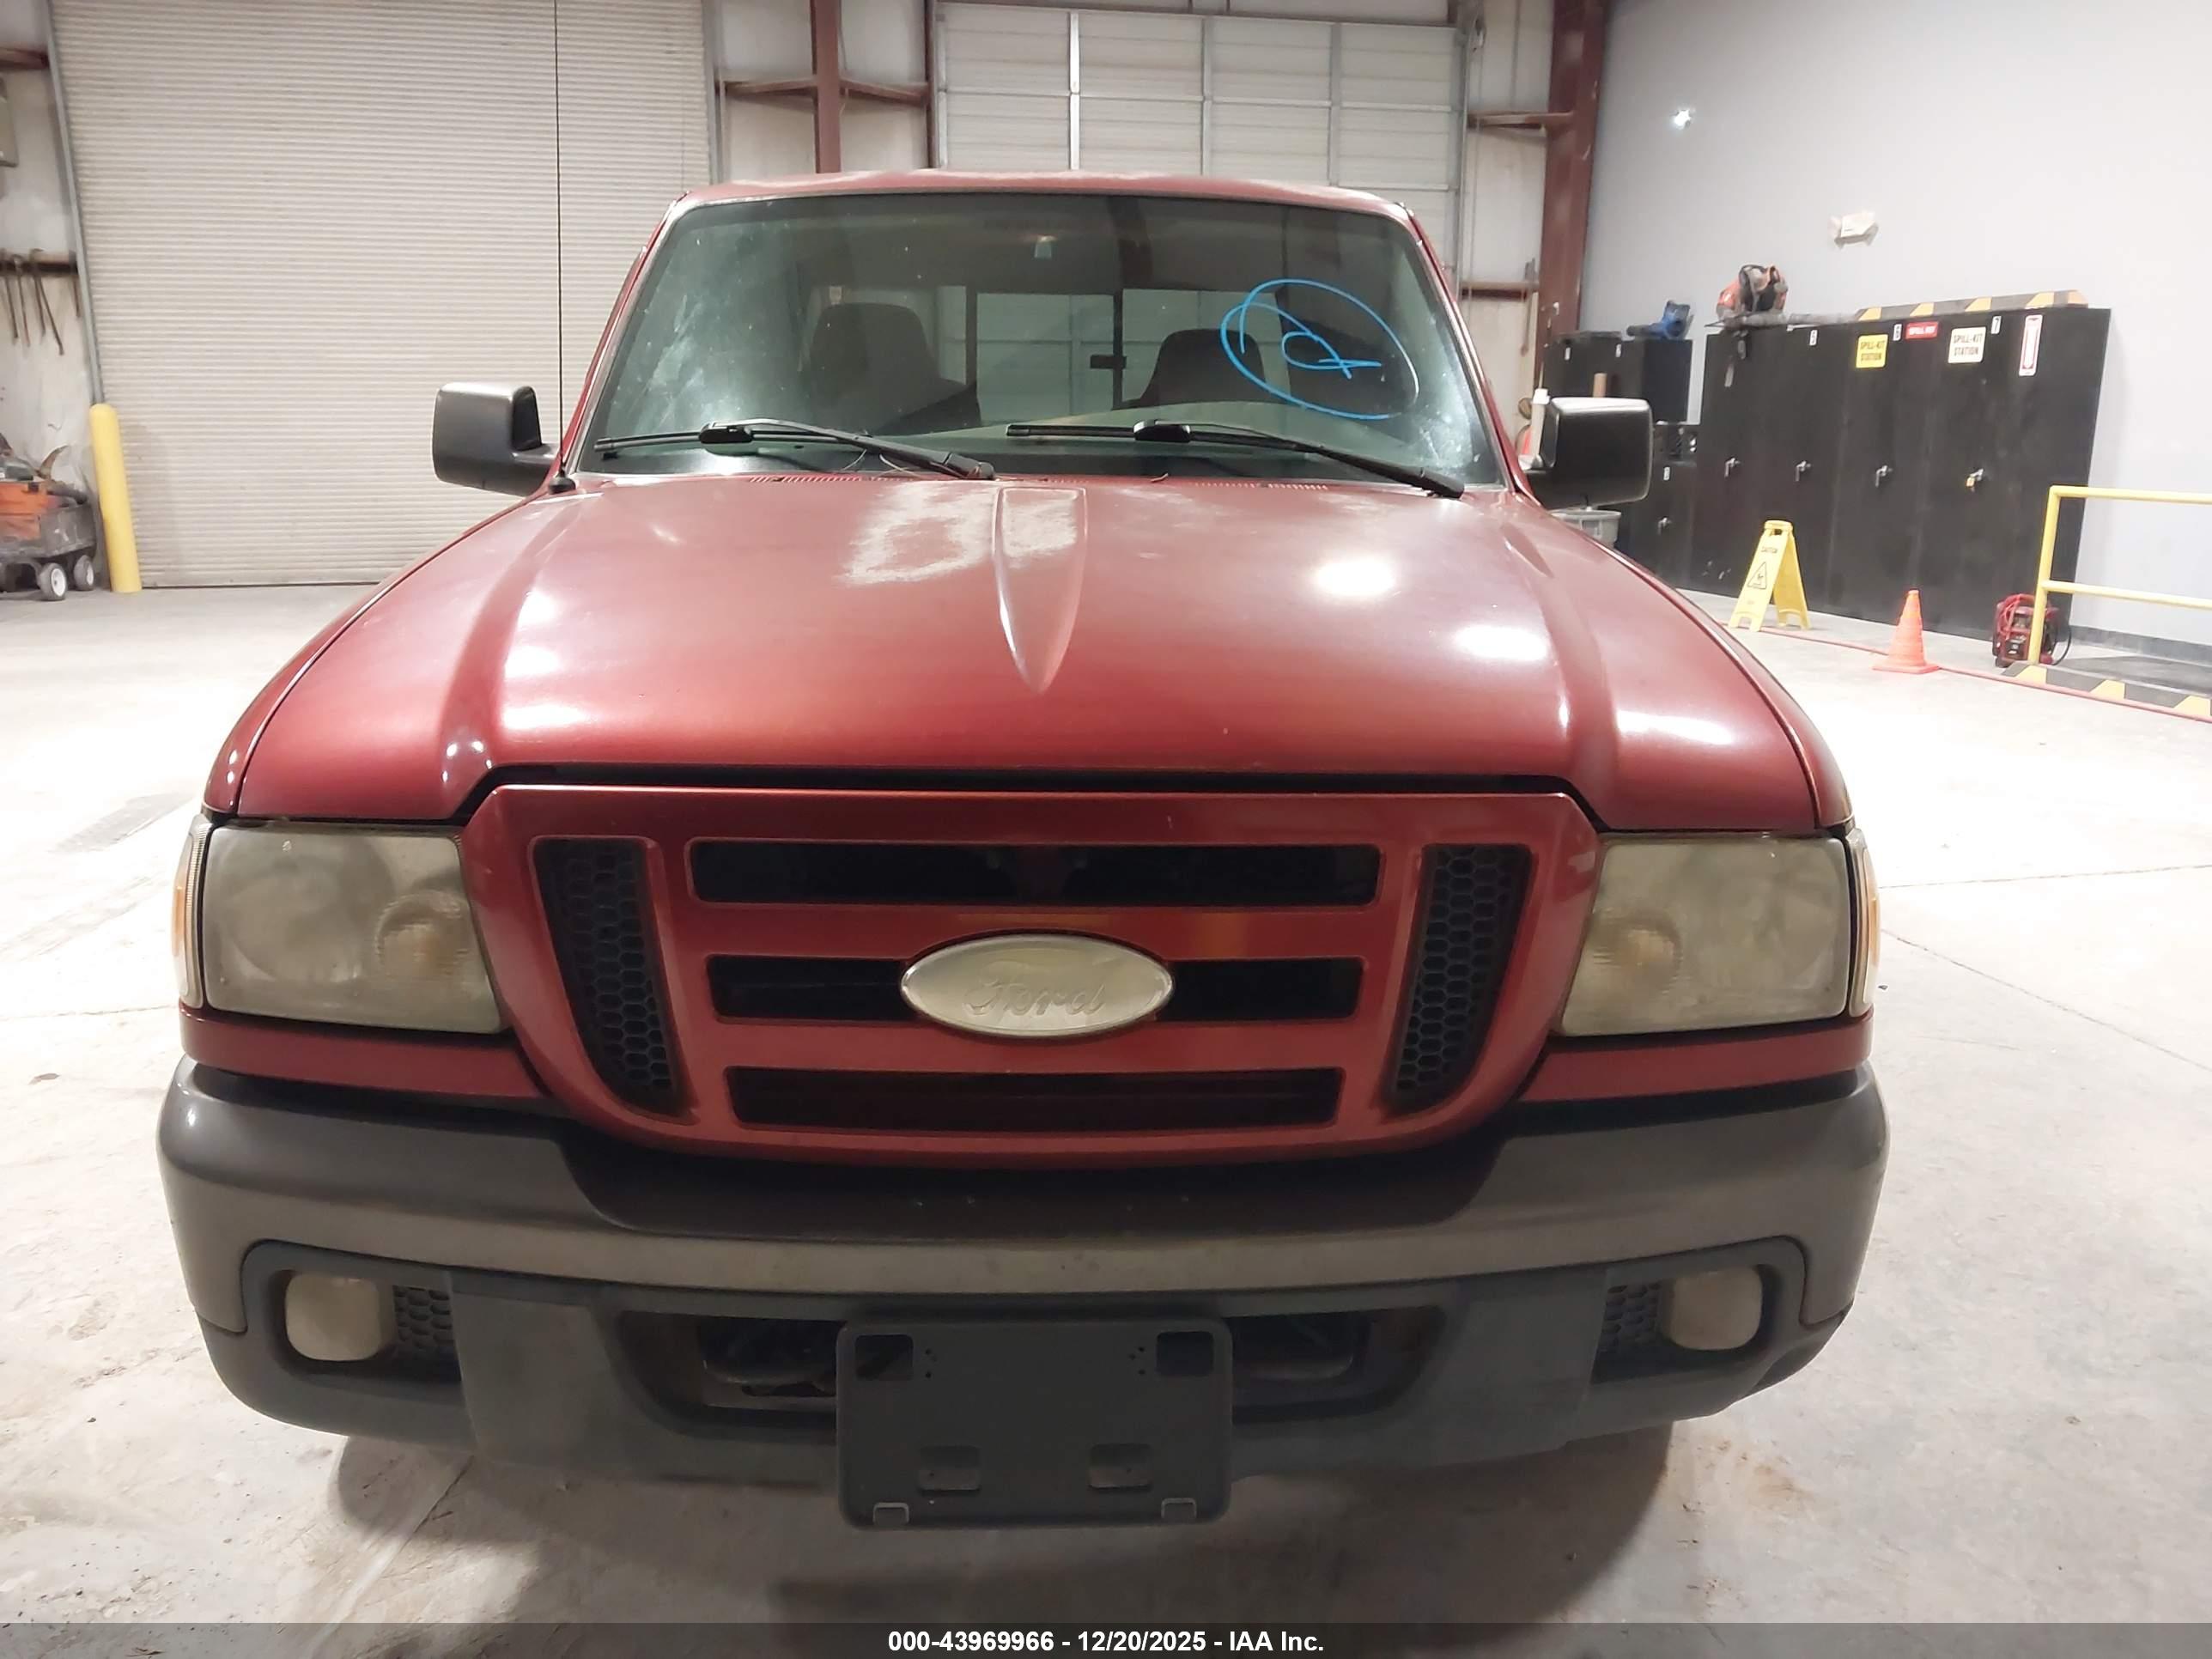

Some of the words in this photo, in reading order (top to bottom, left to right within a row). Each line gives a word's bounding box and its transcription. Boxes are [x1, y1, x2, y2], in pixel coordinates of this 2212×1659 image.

[1953, 332, 1984, 344] SPILL-KIT
[1860, 340, 1886, 350] SPILL-KIT
[1860, 351, 1883, 362] STATION
[1954, 346, 1980, 357] STATION
[962, 962, 1108, 1017] Ford
